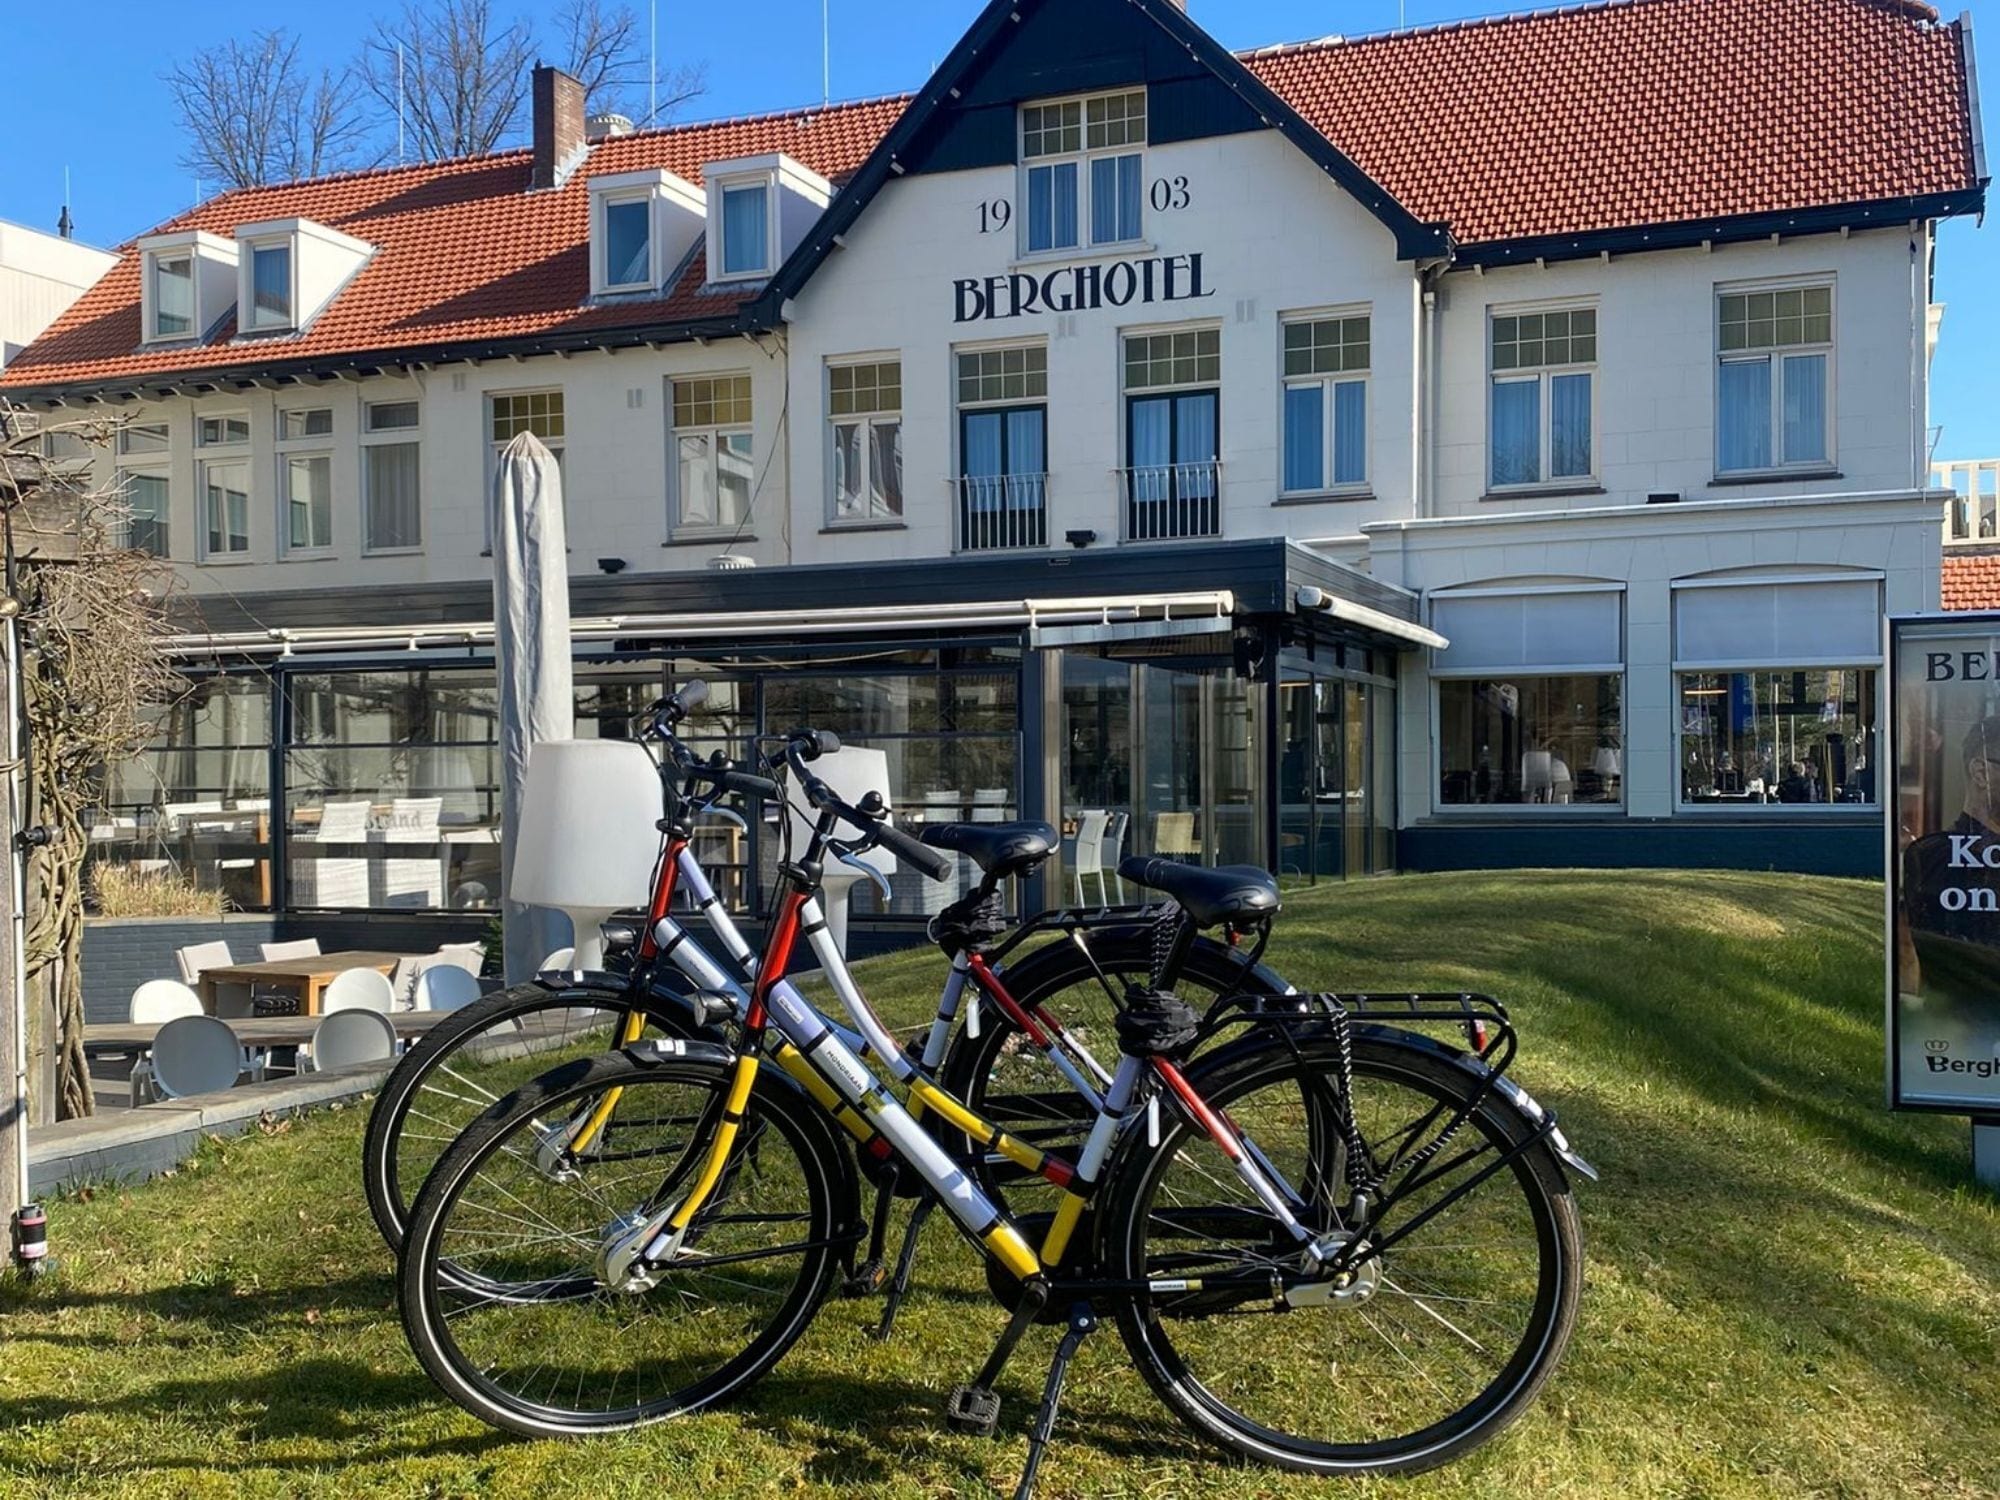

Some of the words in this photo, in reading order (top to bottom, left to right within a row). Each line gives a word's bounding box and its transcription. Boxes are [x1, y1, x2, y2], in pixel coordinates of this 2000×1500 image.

[976, 199, 1011, 233] 19
[1150, 176, 1190, 211] 03
[953, 253, 1216, 322] BERGHOTEL
[1940, 887, 2000, 911] on
